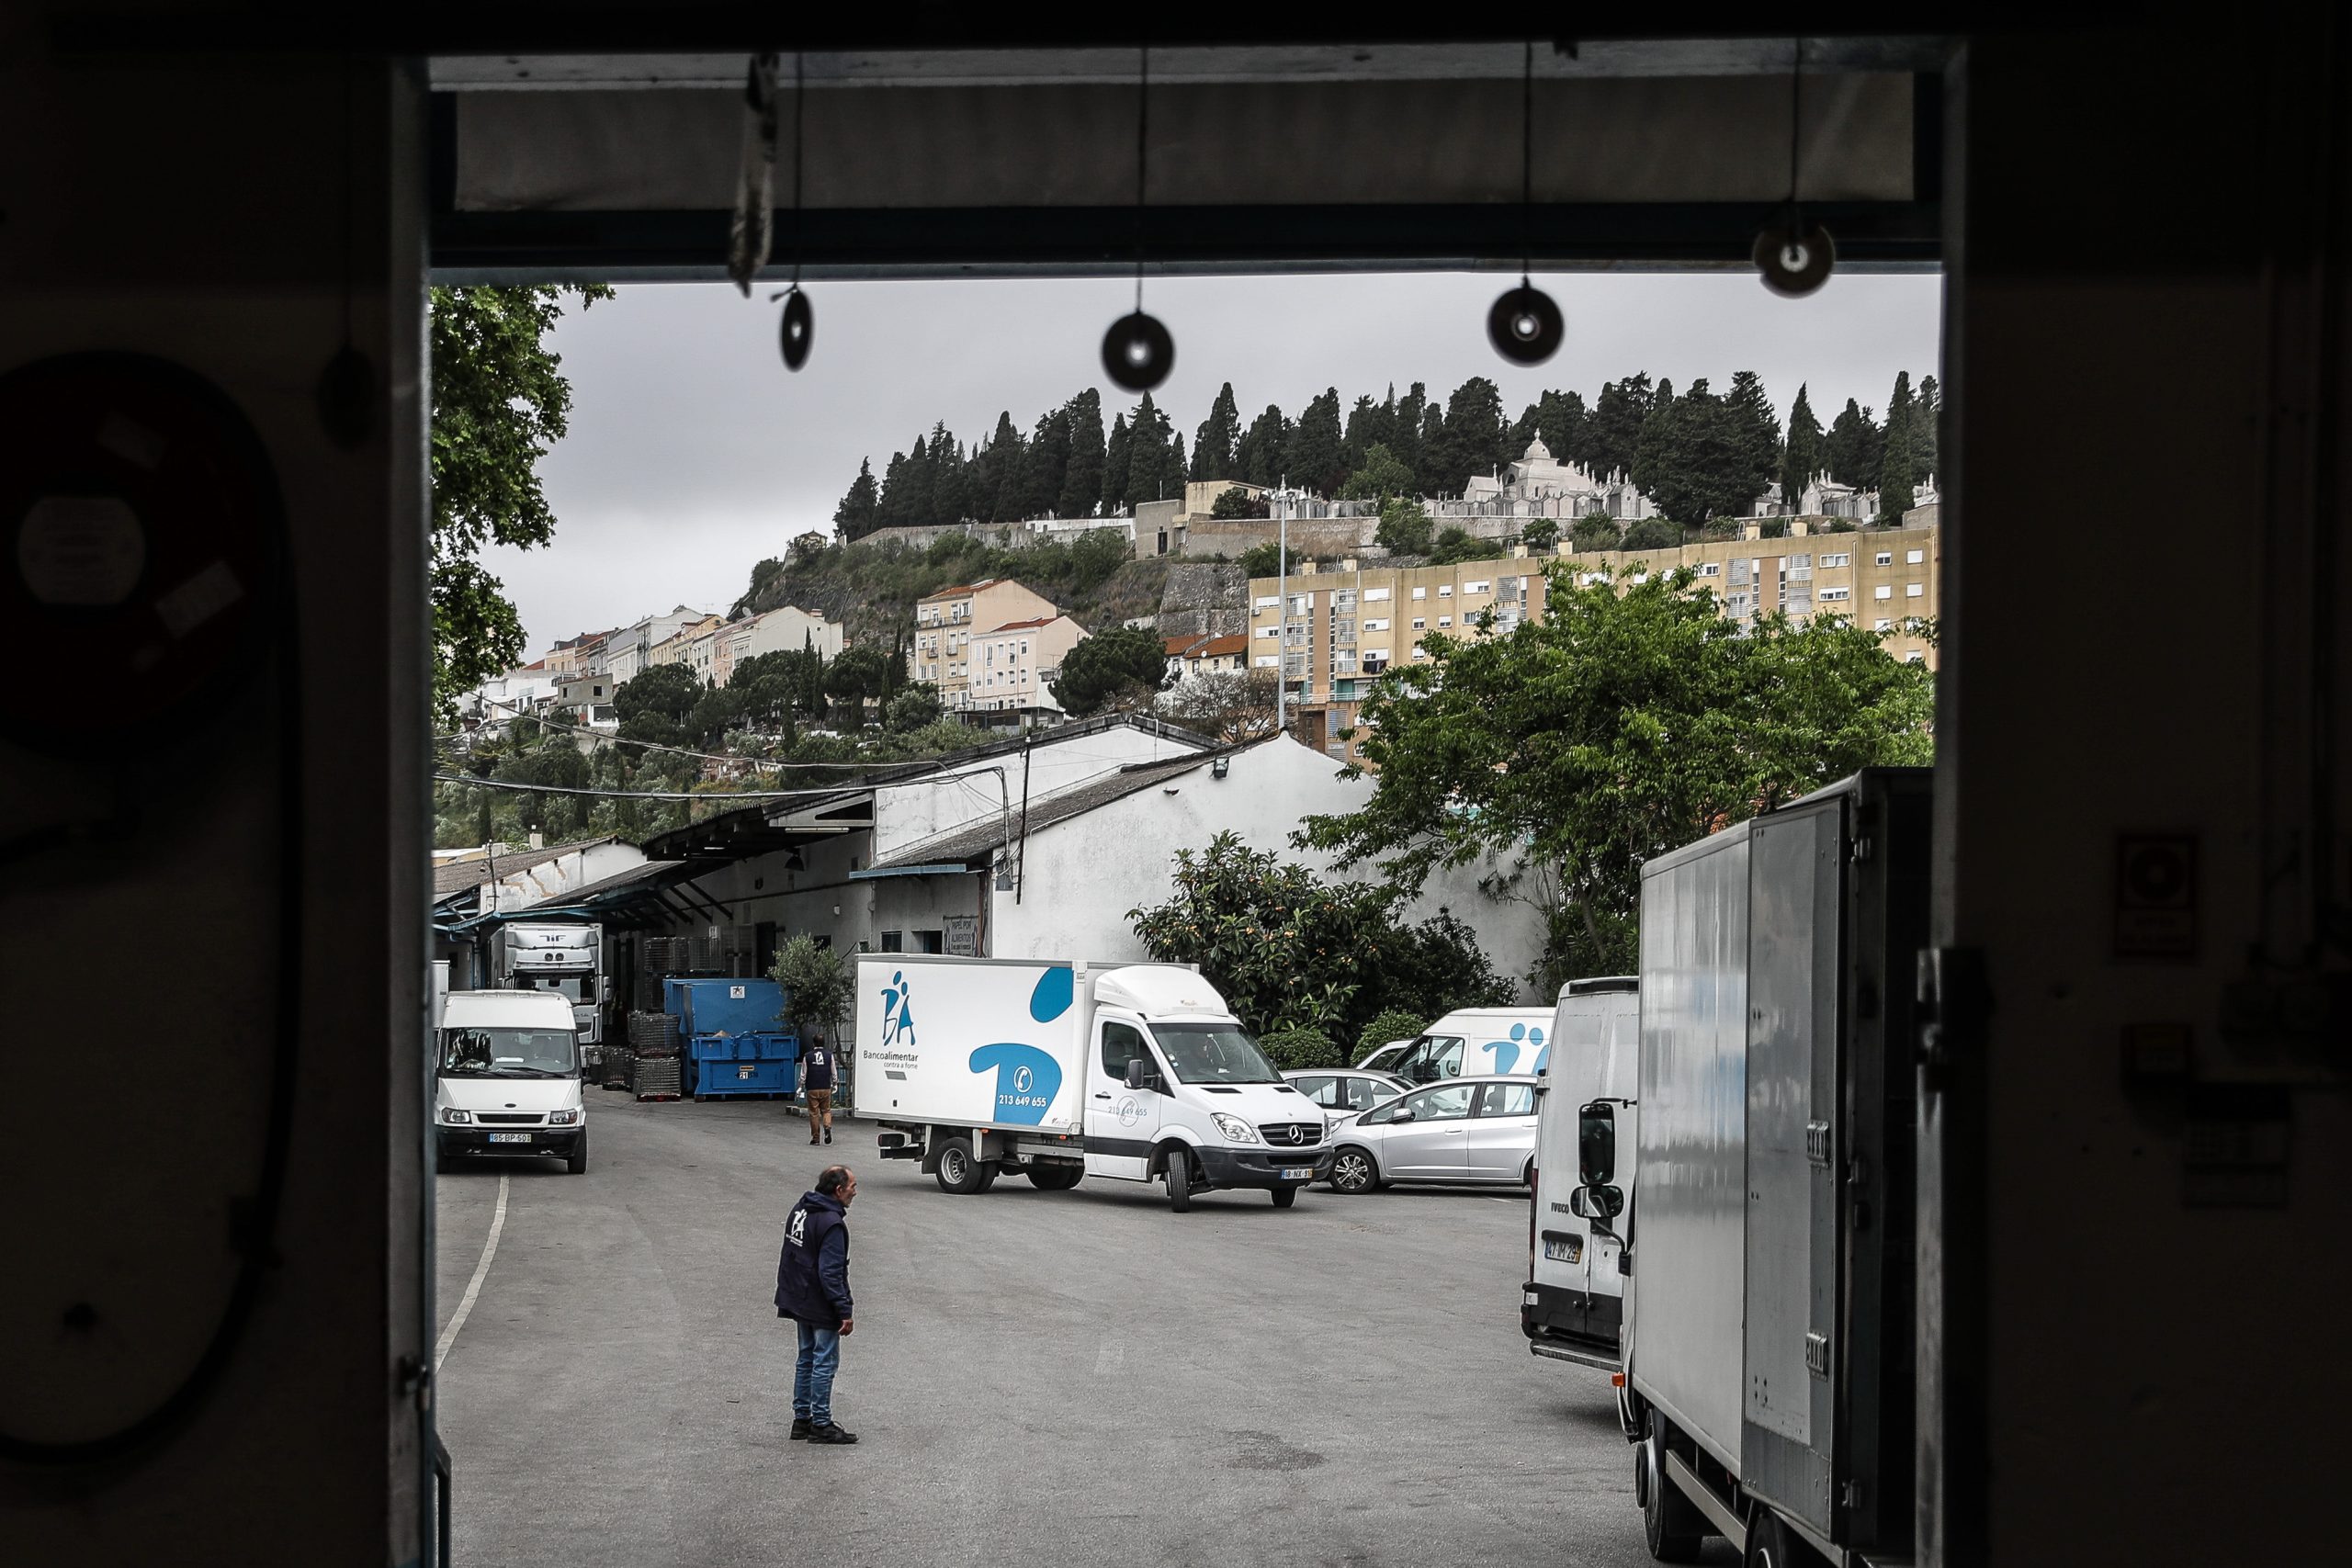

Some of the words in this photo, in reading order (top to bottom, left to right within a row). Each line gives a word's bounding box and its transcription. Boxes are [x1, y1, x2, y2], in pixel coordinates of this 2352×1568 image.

[863, 1049, 919, 1062] Bancoalimentar
[999, 1094, 1014, 1105] 213
[1015, 1095, 1031, 1107] 649
[1032, 1097, 1047, 1108] 655
[1108, 1106, 1120, 1115] 213
[1135, 1108, 1148, 1117] 655
[493, 1134, 527, 1143] 85-BP-50
[1551, 1202, 1569, 1213] IVECO
